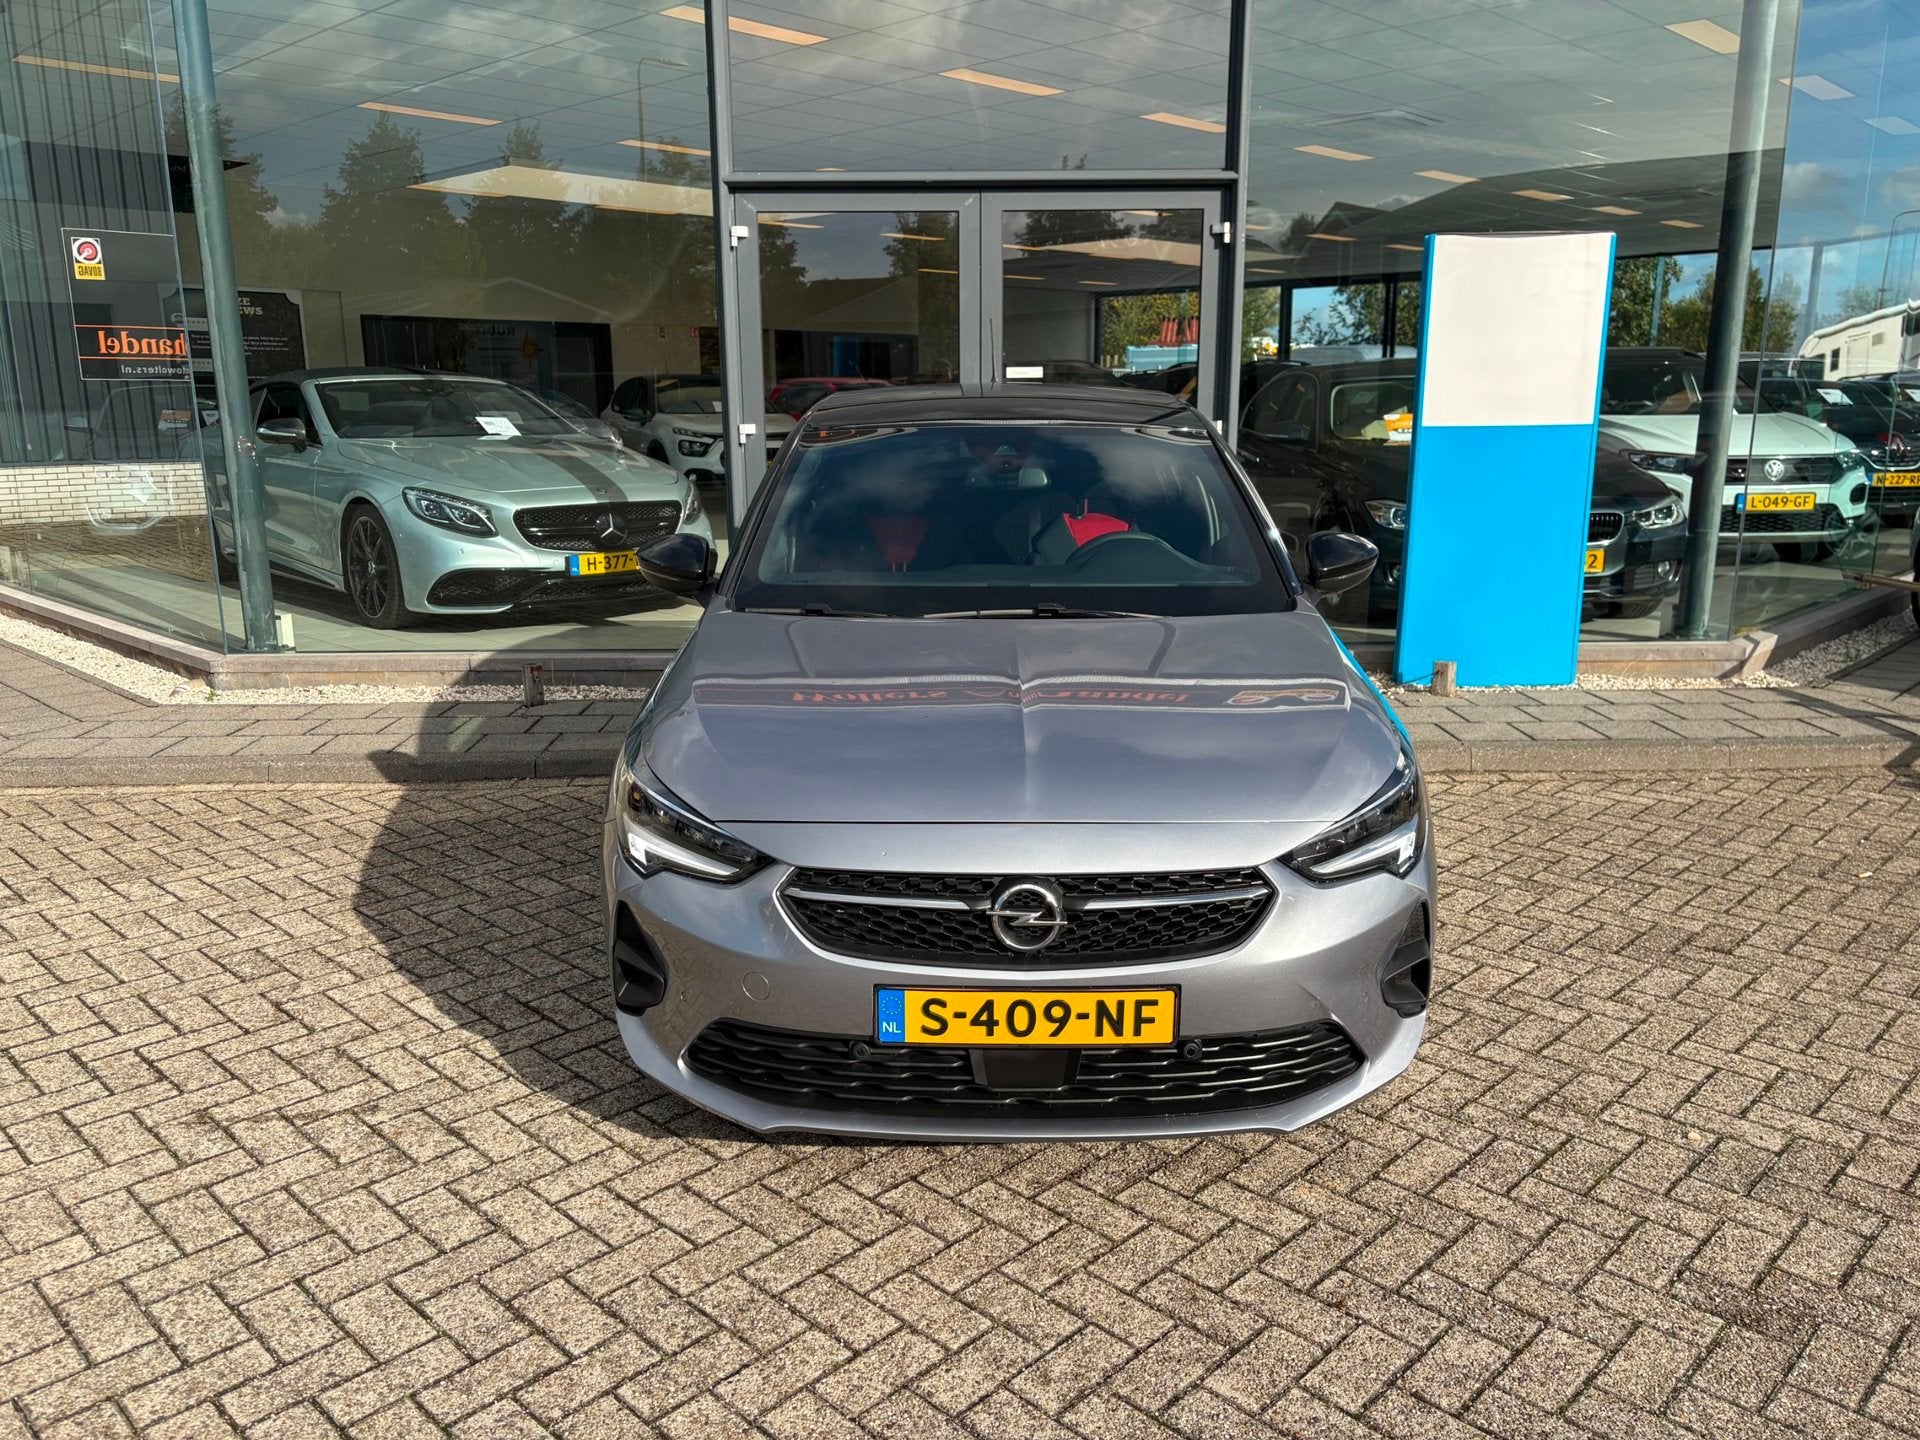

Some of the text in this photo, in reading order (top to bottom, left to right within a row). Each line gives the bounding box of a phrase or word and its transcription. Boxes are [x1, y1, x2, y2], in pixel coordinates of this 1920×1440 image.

[1751, 495, 1811, 508] L-049-GF
[920, 998, 1159, 1038] S-409-NF
[882, 1021, 902, 1033] NL
